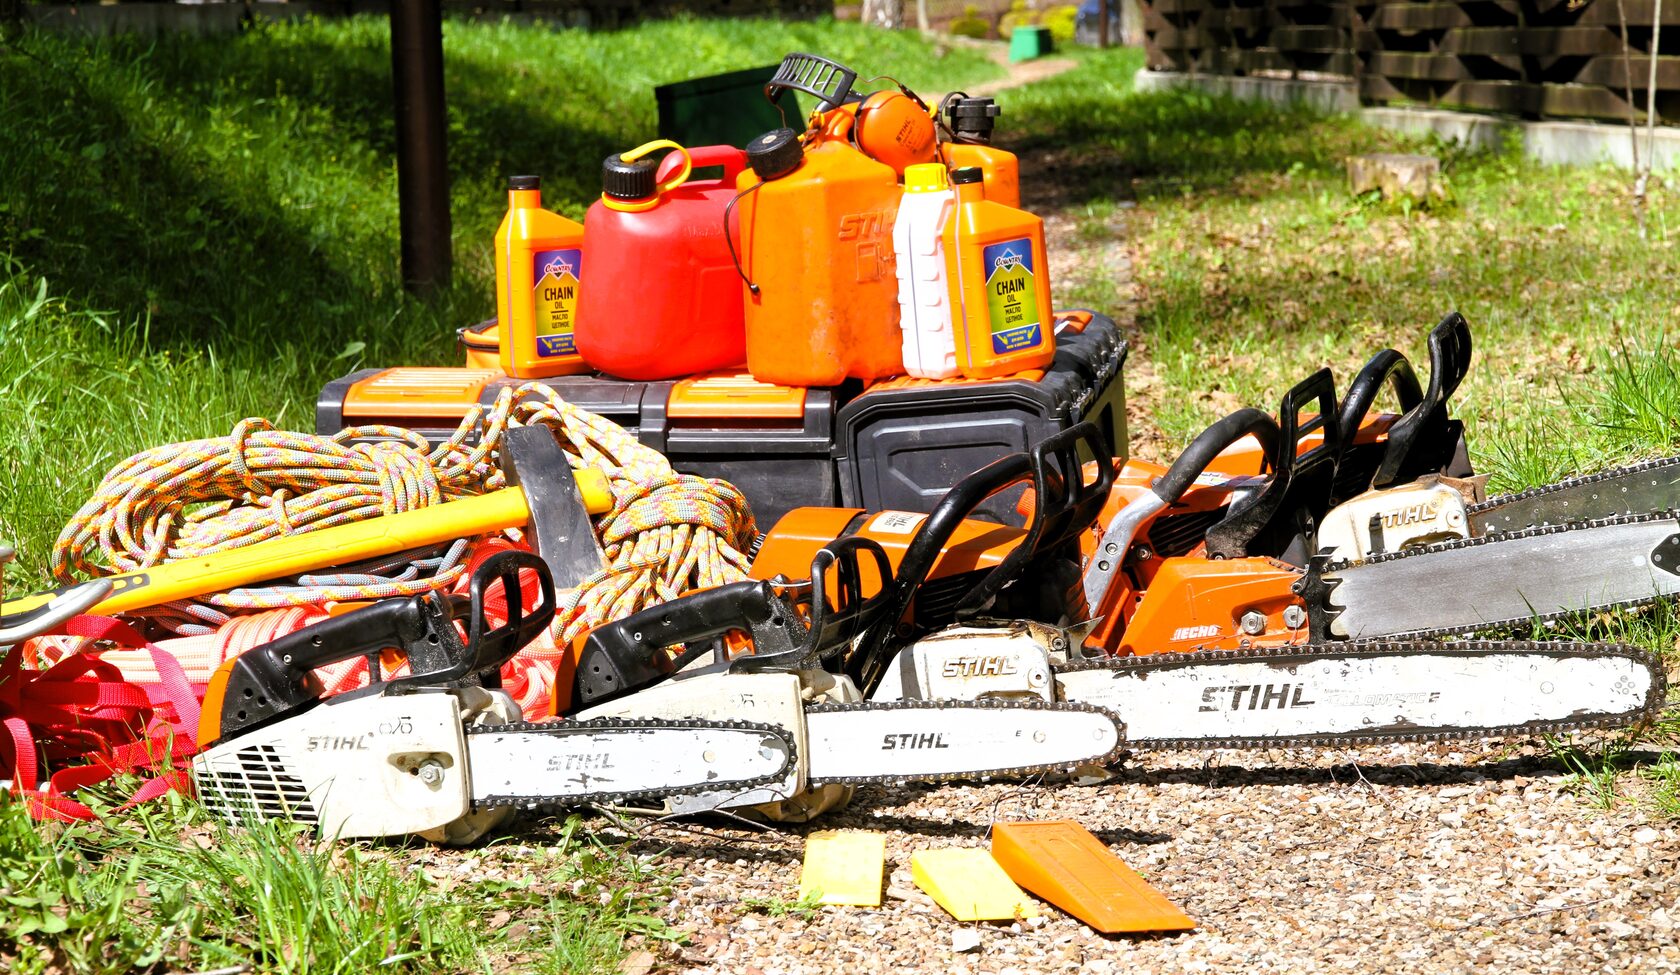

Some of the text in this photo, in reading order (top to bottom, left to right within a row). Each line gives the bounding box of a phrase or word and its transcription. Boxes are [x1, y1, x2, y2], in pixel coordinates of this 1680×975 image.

[838, 210, 899, 240] STIH
[544, 286, 573, 301] CHAIN
[996, 277, 1025, 296] CHAIN
[554, 301, 564, 309] OIL
[1006, 294, 1017, 303] OIL
[942, 656, 1018, 677] STIHL
[1198, 682, 1316, 712] STIHL
[307, 735, 369, 751] STIHL
[881, 733, 949, 750] STIHL
[546, 753, 615, 771] STIHL
